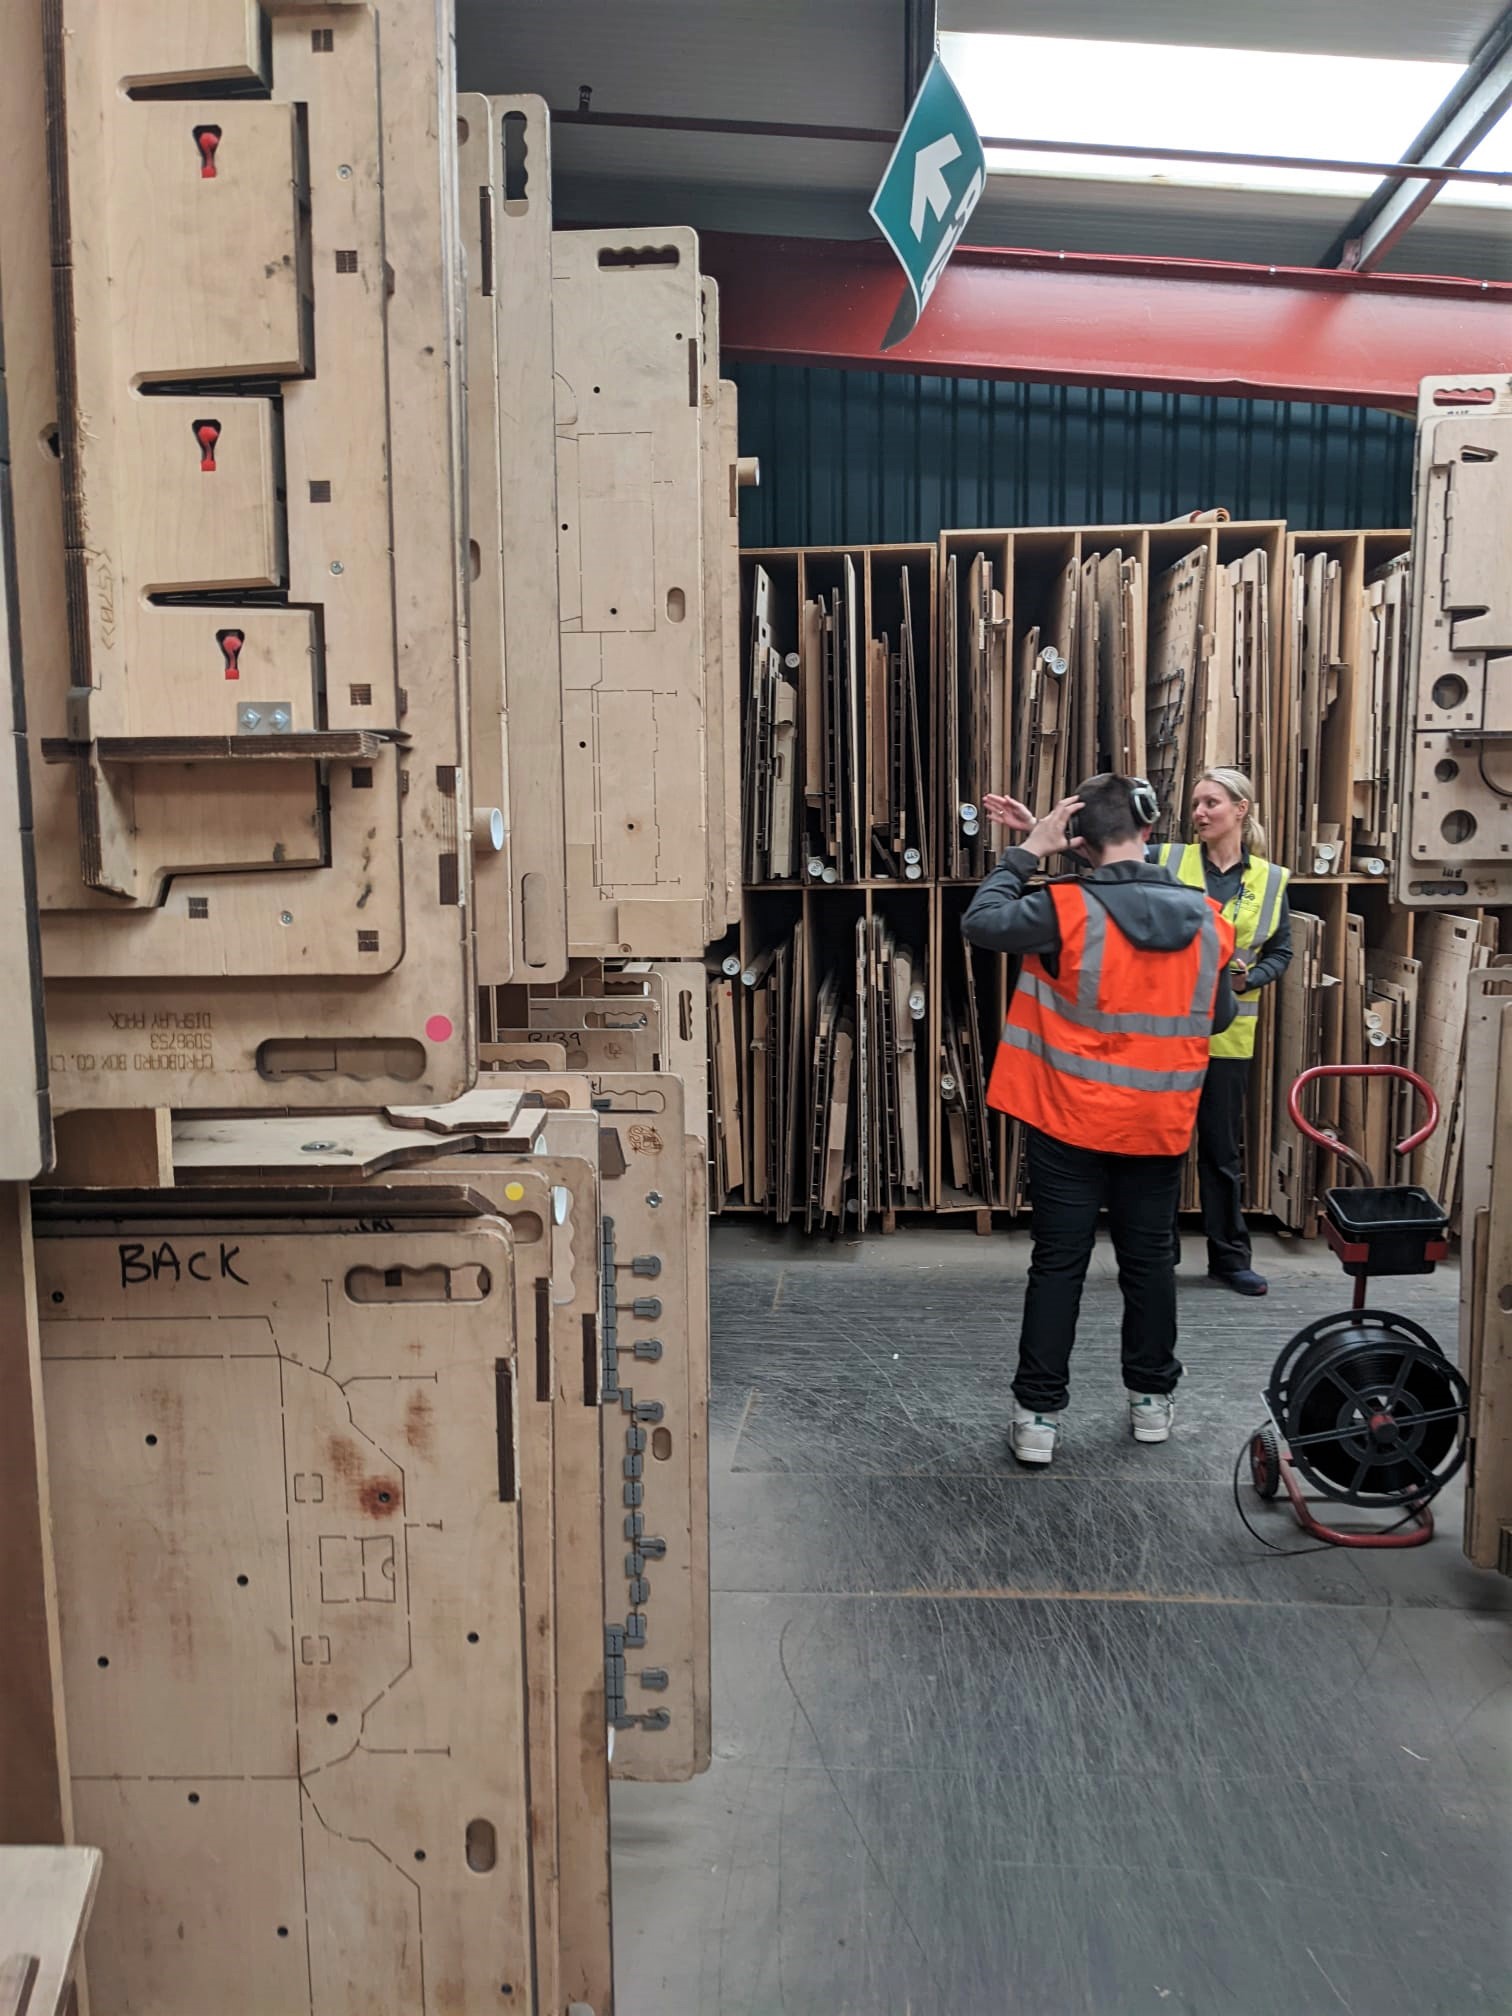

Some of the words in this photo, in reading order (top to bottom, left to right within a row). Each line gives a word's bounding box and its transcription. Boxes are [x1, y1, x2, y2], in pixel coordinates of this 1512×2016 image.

[108, 1011, 146, 1030] PACK
[151, 1012, 213, 1030] DISPLAY
[150, 1033, 213, 1050] SD98753
[102, 1053, 127, 1071] BOX
[134, 1053, 214, 1071] CARDBOARD
